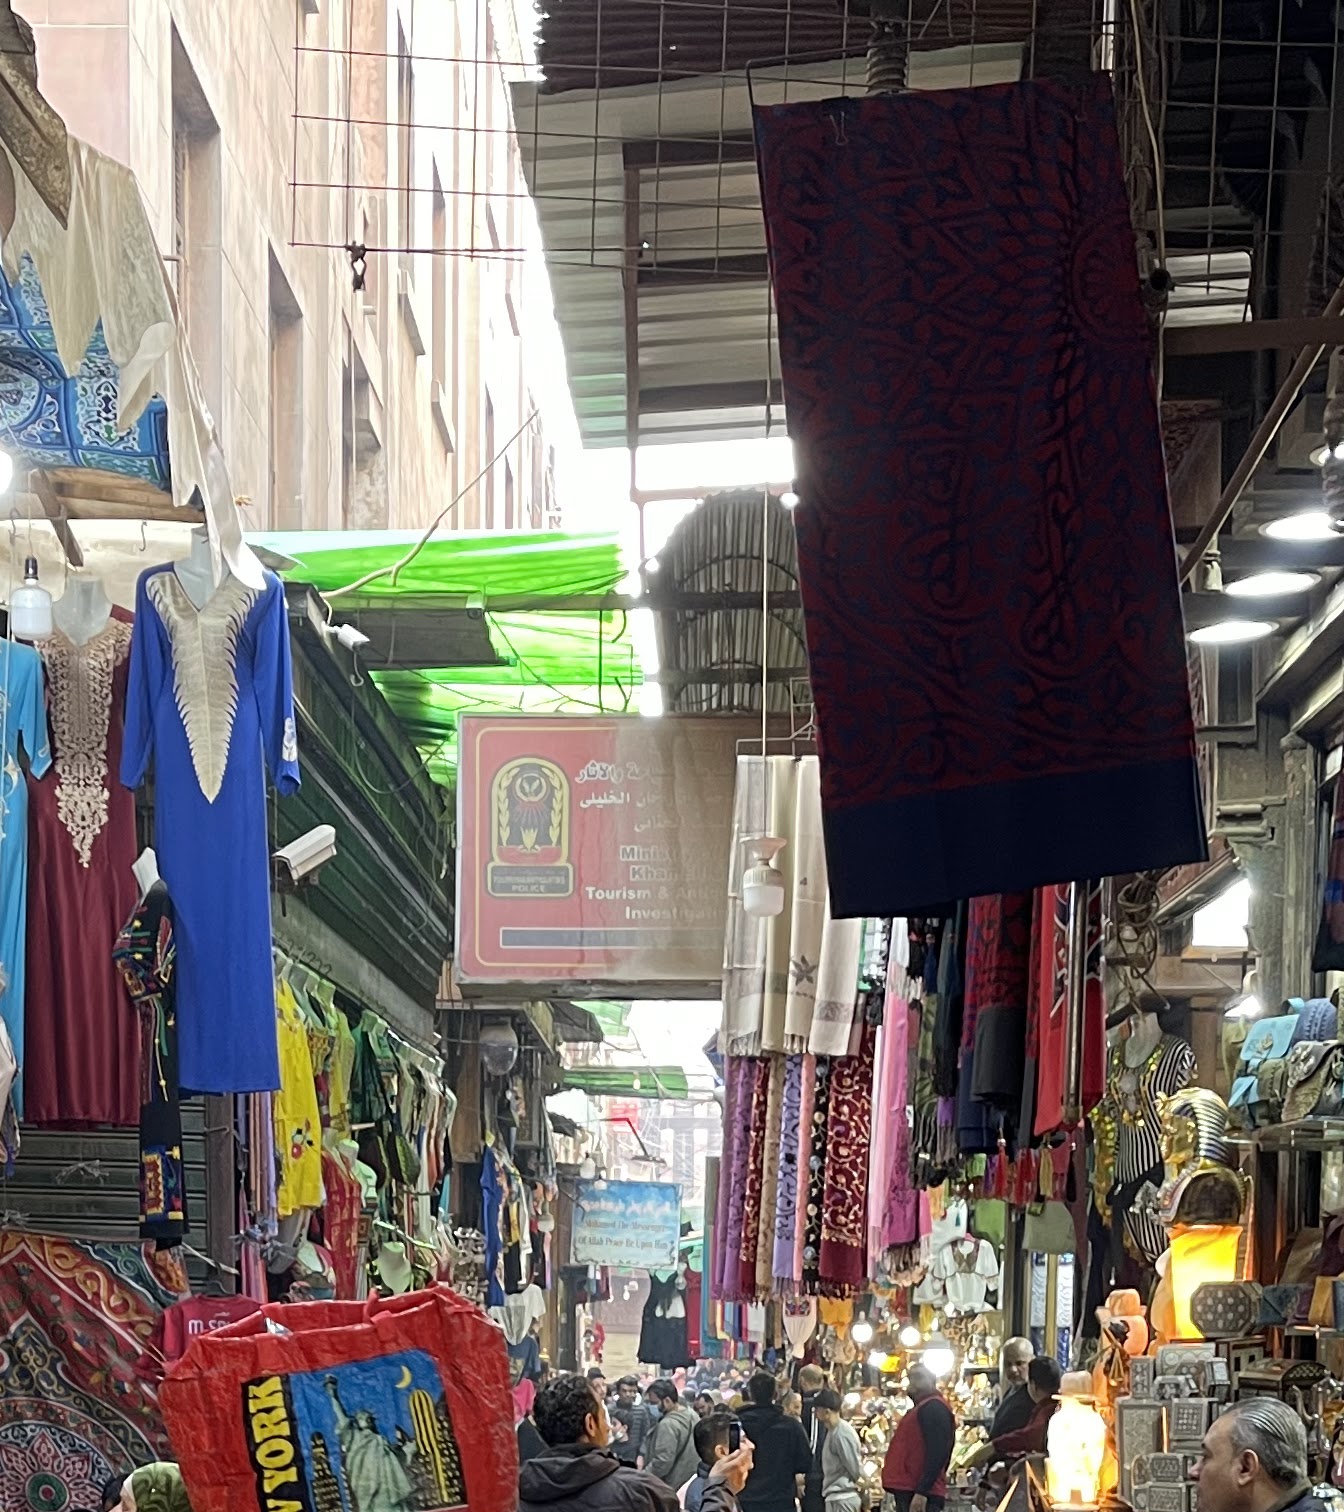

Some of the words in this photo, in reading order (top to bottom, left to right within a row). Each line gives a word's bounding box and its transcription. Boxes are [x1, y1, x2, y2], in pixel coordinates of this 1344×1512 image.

[511, 884, 545, 894] POLICE
[585, 886, 650, 901] Tourism
[247, 1375, 299, 1491] YORK
